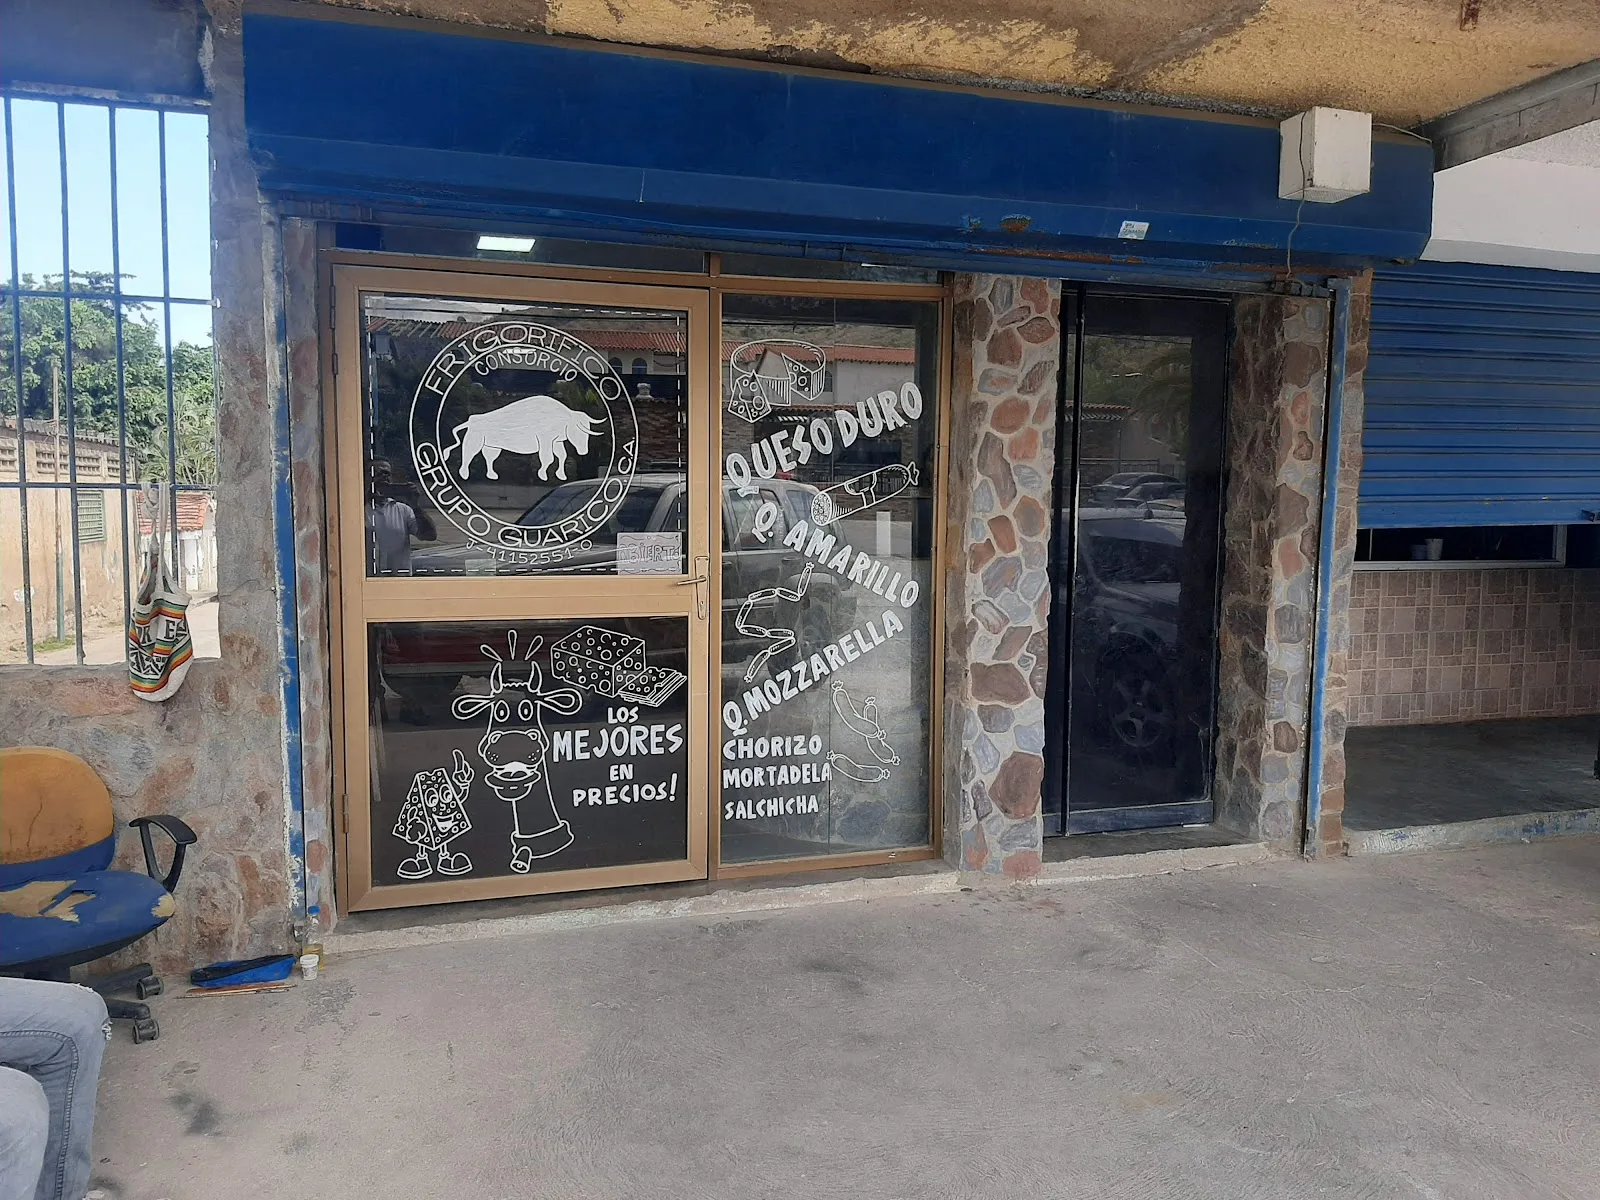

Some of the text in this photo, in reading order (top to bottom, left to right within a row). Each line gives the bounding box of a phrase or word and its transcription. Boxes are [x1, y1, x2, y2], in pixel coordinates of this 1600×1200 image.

[424, 324, 622, 401] FRIGORIFICO
[474, 350, 578, 382] CONSORCIO
[725, 381, 923, 498] QUESO DURO
[416, 442, 491, 537] GRUPO
[782, 519, 920, 608] AMARILLO
[607, 706, 639, 724] LOS
[552, 723, 684, 763] MEJORES
[722, 734, 823, 761] CHORIZO
[609, 763, 634, 782] EN
[722, 762, 833, 789] MORTADELA
[572, 772, 679, 808] PRECIOS!
[724, 794, 820, 821] SALCHICHA
